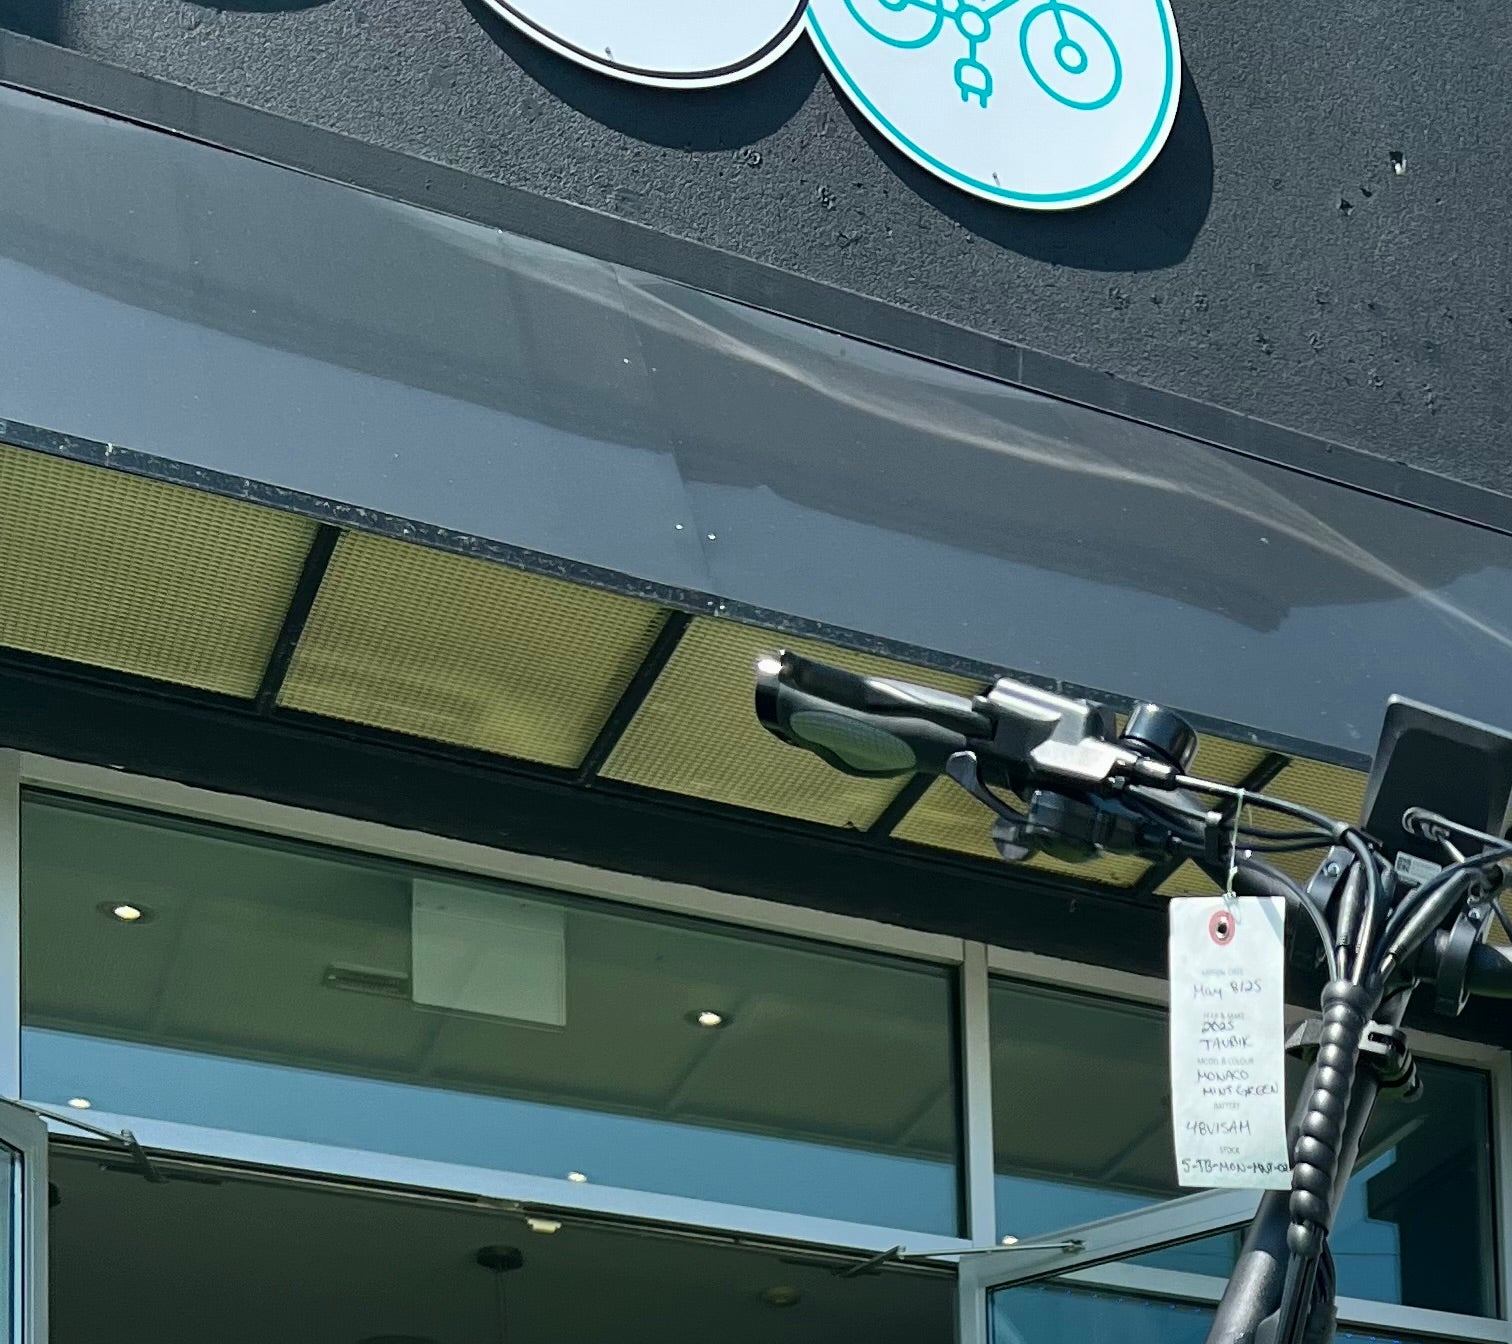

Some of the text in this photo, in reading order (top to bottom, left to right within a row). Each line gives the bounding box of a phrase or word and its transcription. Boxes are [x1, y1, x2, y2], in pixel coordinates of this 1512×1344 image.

[1192, 983, 1223, 1001] May
[1201, 1020, 1235, 1034] 2025
[1199, 1035, 1253, 1052] TAUBIK
[1196, 1069, 1249, 1082] MONACO
[1202, 1082, 1279, 1098] MINT GREEN
[1219, 1145, 1241, 1155] STOCK
